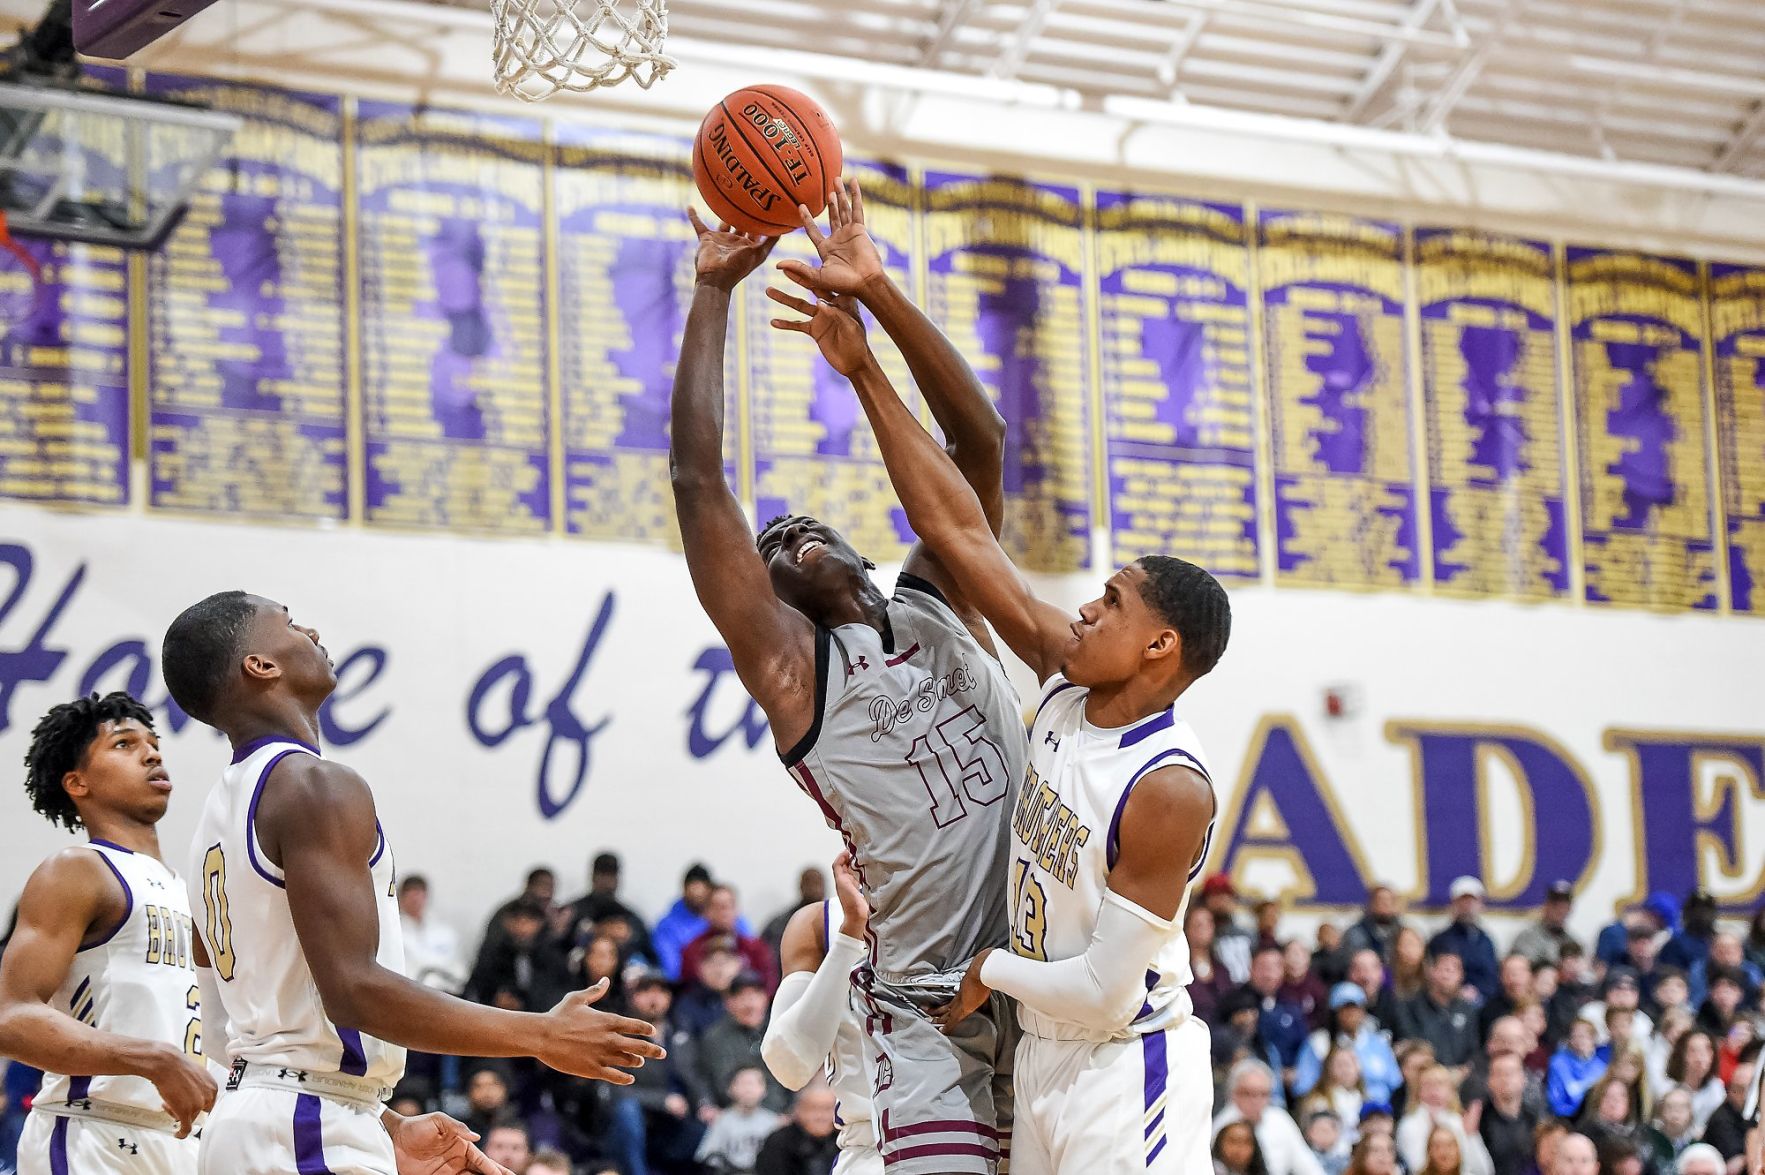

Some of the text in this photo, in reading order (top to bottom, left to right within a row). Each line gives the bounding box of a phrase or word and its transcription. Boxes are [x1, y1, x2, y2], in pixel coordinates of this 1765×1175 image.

[708, 123, 781, 212] SPALDING
[743, 104, 810, 186] TF-1000
[468, 591, 612, 819] of
[868, 695, 914, 743] De
[905, 704, 1010, 830] 15
[1188, 713, 1765, 917] ADE
[203, 842, 236, 982] 0
[1011, 857, 1048, 962] 13
